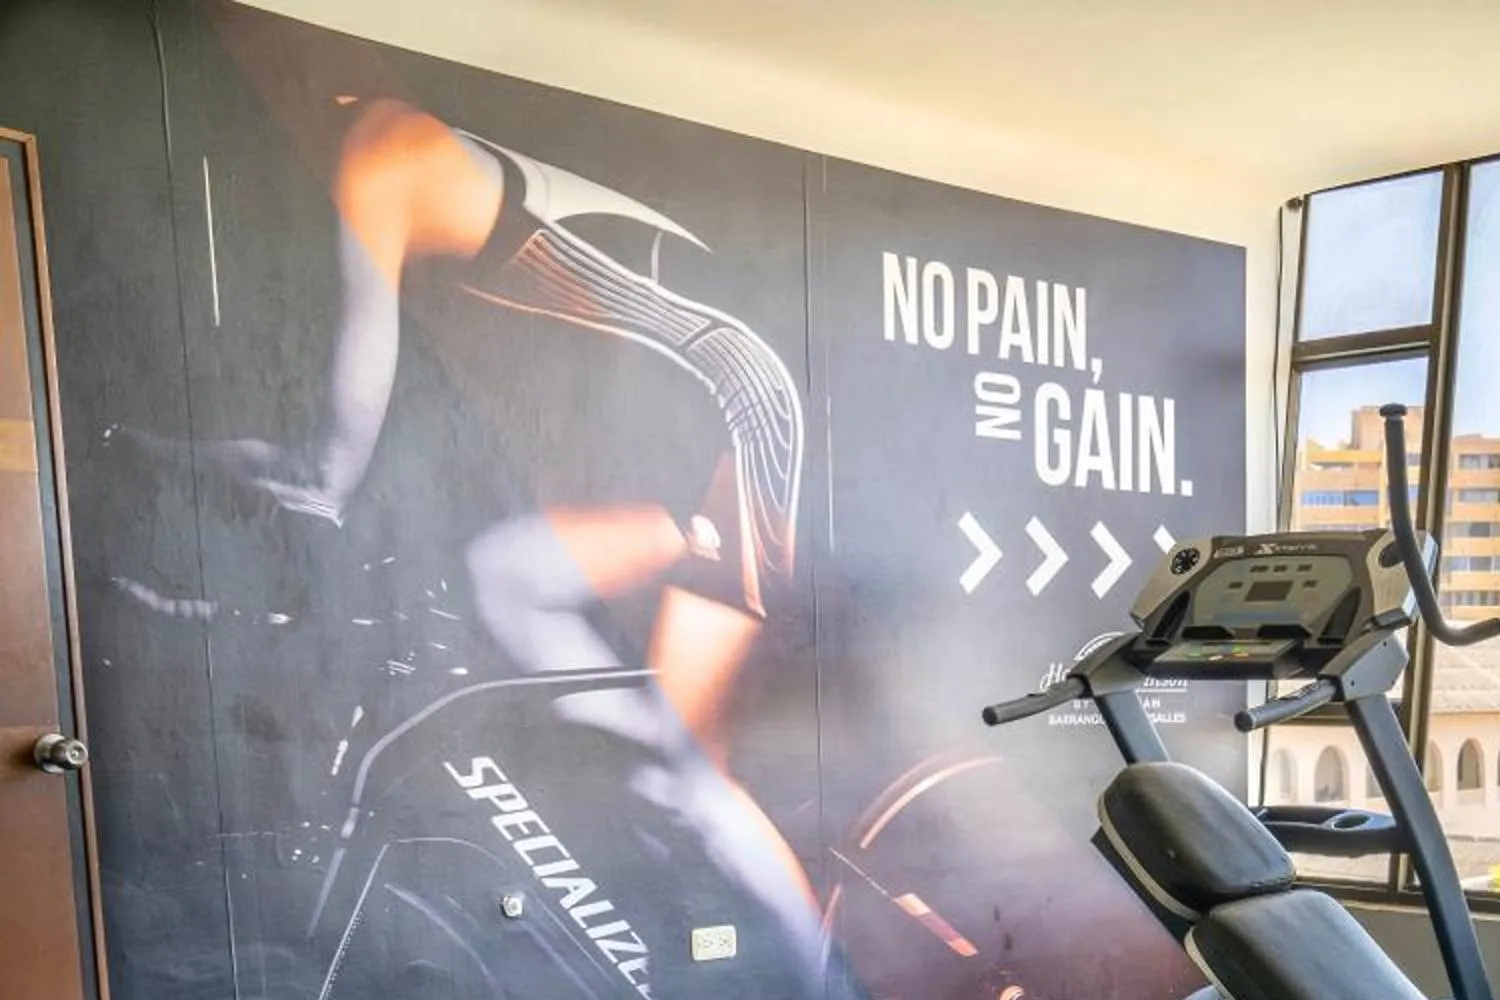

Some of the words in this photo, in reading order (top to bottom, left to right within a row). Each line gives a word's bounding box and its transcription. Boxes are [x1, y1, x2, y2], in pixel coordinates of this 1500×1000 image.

[883, 252, 955, 351] NO
[967, 268, 1103, 385] PAIN,
[974, 372, 1022, 441] NO
[1034, 382, 1193, 497] GAIN.
